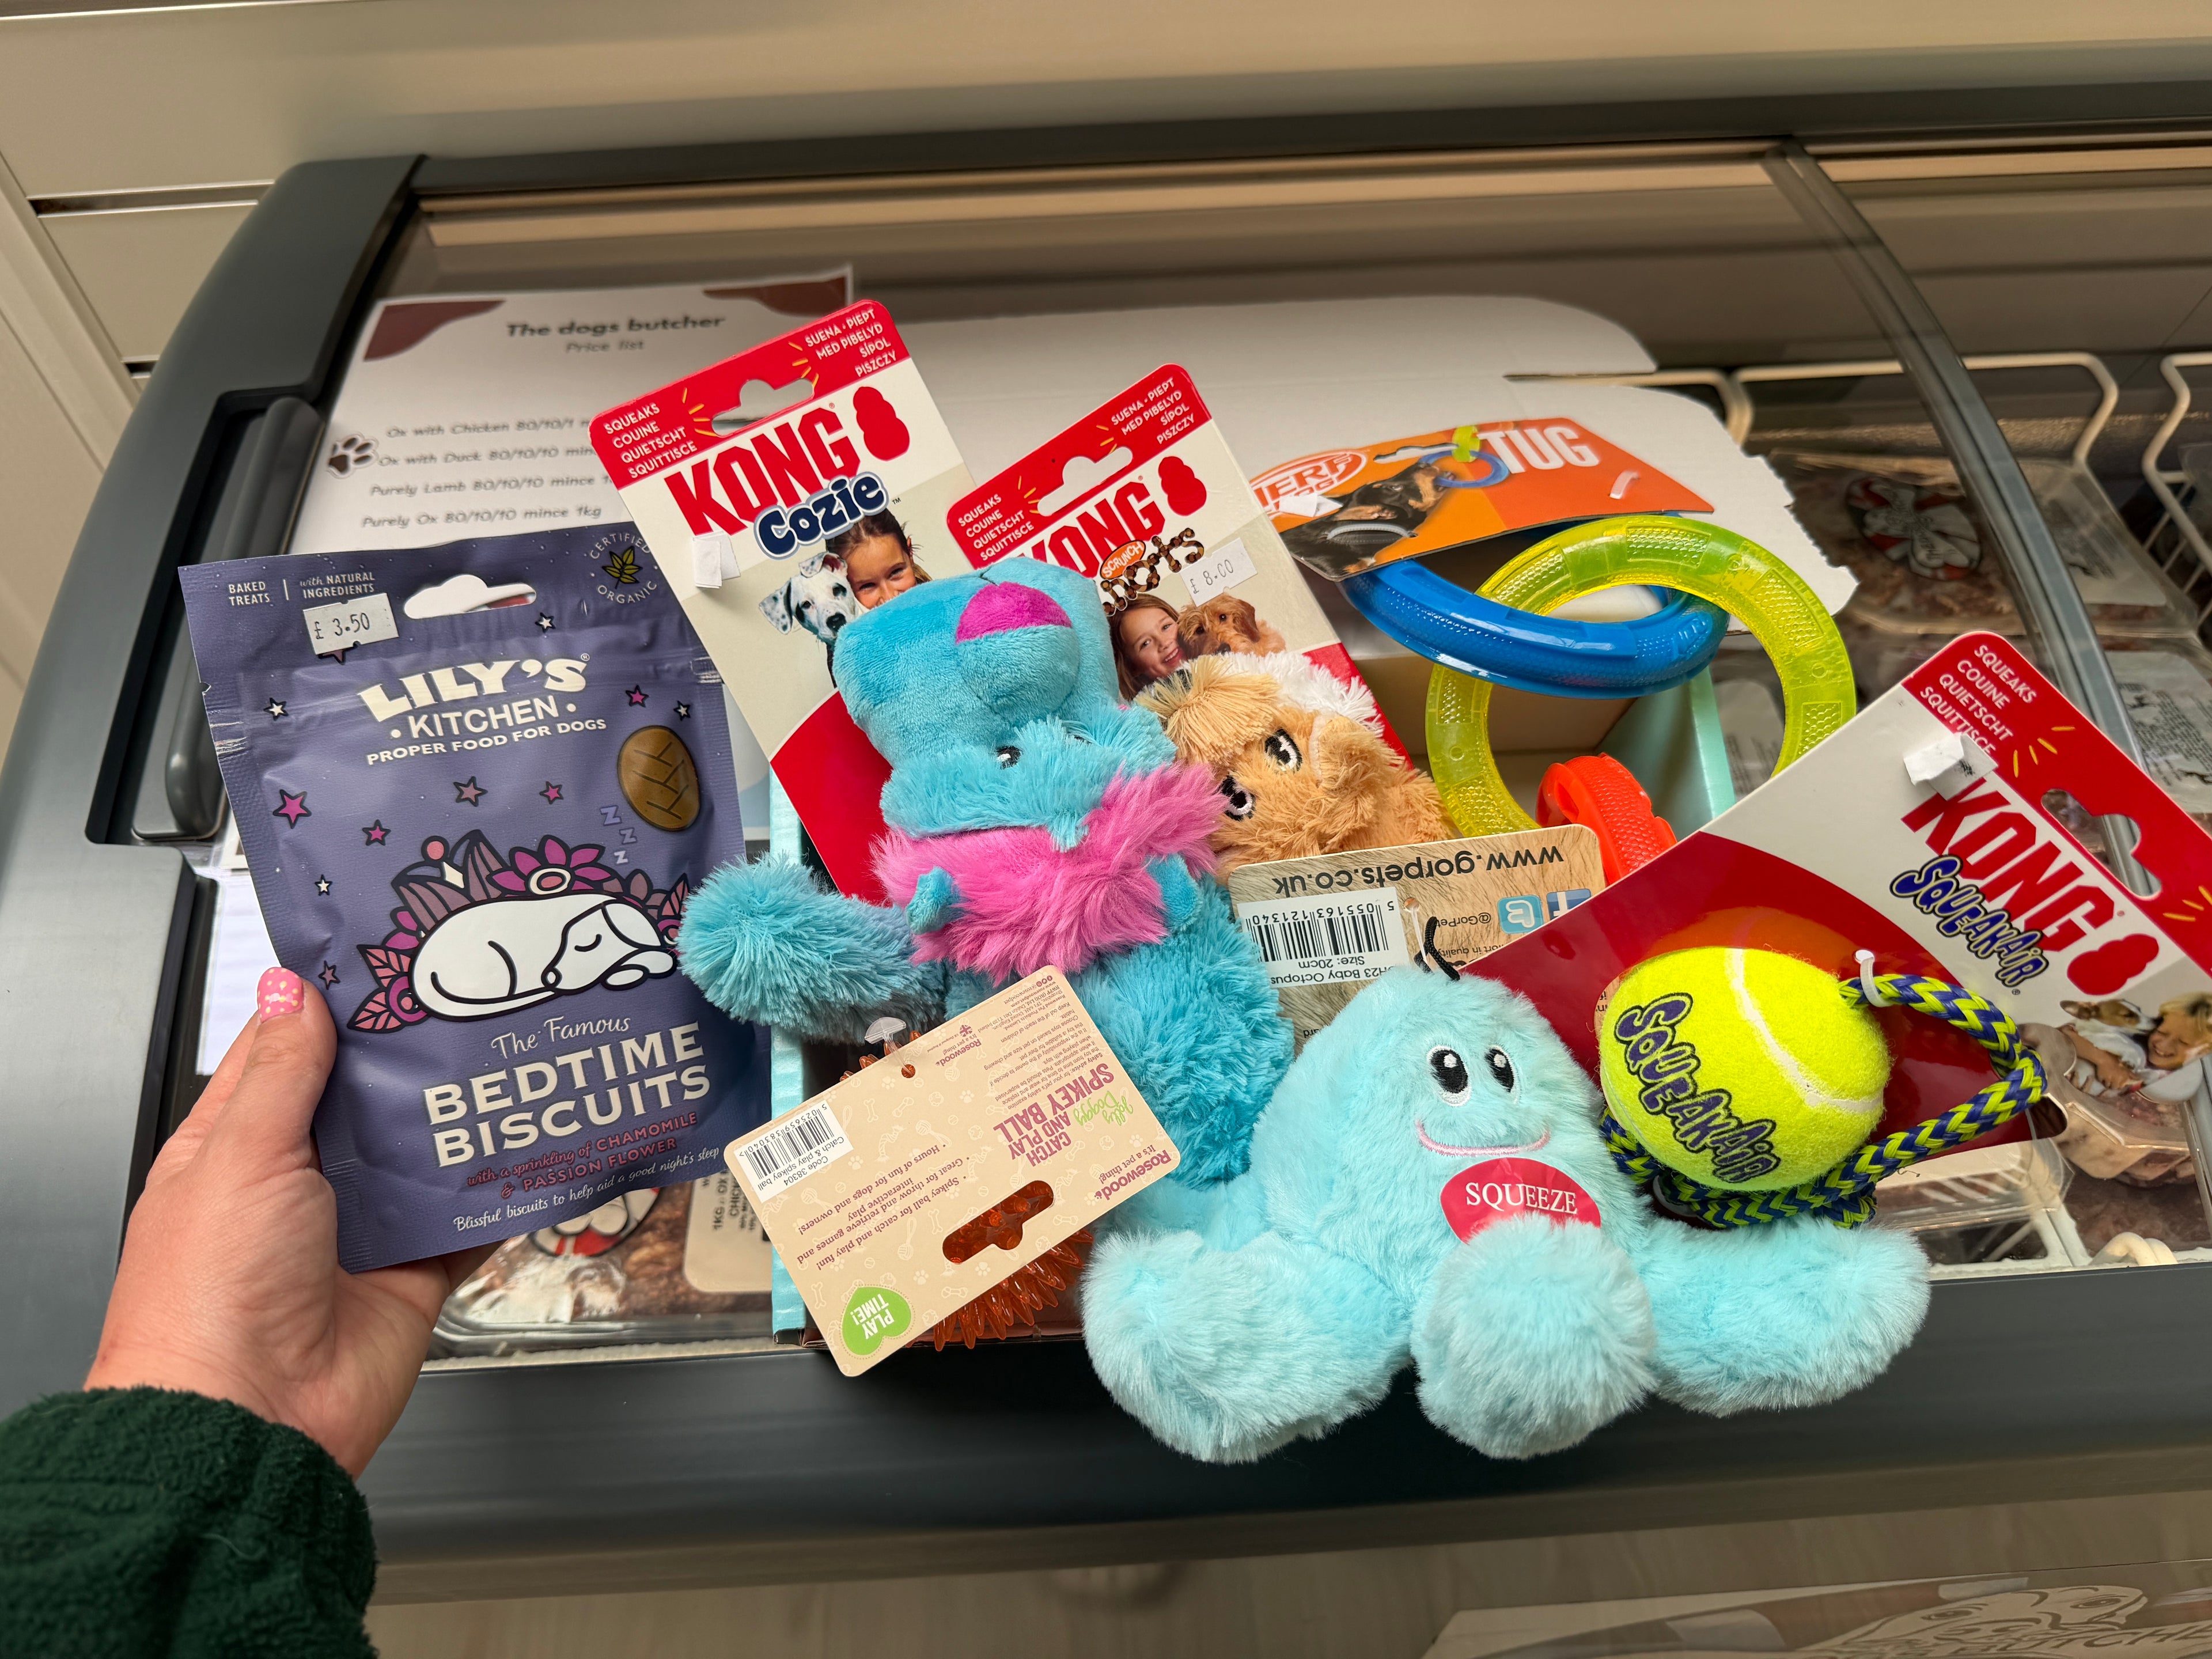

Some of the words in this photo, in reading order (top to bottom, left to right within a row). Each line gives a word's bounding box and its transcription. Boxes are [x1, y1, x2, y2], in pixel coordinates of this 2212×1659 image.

[506, 324, 549, 342] The
[559, 321, 618, 335] dogs
[628, 315, 724, 331] butcher
[806, 326, 842, 346] SUENA
[846, 309, 874, 328] PIEPT
[567, 342, 609, 358] Price
[619, 340, 644, 351] list
[816, 343, 840, 359] MED
[840, 324, 884, 349] PIBELYD
[860, 338, 891, 357] SÍPOL
[855, 351, 896, 377] PISZCZY
[1112, 402, 1143, 425] SUENA
[1148, 378, 1173, 401] PIEPT
[1122, 417, 1142, 435] MED
[1143, 392, 1181, 421] PIBELYD
[1161, 404, 1189, 425] SÍPOL
[605, 404, 660, 434] SQUEAKS
[1157, 414, 1194, 444] PISZCZY
[613, 422, 660, 448] COUINE
[622, 427, 685, 463] QUIETSCHT
[629, 441, 697, 478] SQUITTISCE
[1477, 426, 1600, 474] TUG
[664, 407, 861, 535] KONG
[756, 473, 887, 558] Cozie
[959, 495, 1001, 526] SQUEAKS
[967, 510, 1002, 537] COUINE
[974, 510, 1024, 548] QUIETSCHT
[980, 522, 1034, 560] SQUITTISCE
[590, 533, 650, 559] CERTIFIED
[1103, 542, 1144, 577] SCRUNCH
[229, 581, 266, 593] BAKED
[300, 577, 323, 586] with
[326, 572, 375, 584] NATURAL
[303, 584, 374, 599] INGREDIENTS
[1190, 578, 1199, 594] £
[229, 593, 270, 606] TREATS
[598, 581, 657, 604] ORGANIC
[315, 622, 324, 639] £
[332, 613, 370, 636] 3.50
[1957, 659, 2010, 710] COUINE
[1974, 645, 2037, 703] SQUEAKS
[358, 658, 587, 722] LILY'S
[409, 696, 560, 739] KITCHEN
[1939, 673, 2013, 741] QUIETSCHT
[367, 743, 446, 765] PROPER
[452, 735, 507, 751] FOOD
[512, 726, 551, 741] FOR
[557, 718, 608, 733] DOGS
[1272, 846, 1564, 897] www.gorpets.co.uk
[1901, 778, 2114, 952] KONG
[1252, 910, 1308, 925] 121340
[1316, 903, 1374, 918] 055163
[1298, 959, 1333, 968] 20cm
[1337, 956, 1365, 965] Size:
[1270, 973, 1324, 984] Octopus
[1328, 969, 1360, 980] Baby
[491, 1033, 539, 1060] The
[544, 1016, 631, 1041] Famous
[423, 1022, 704, 1125] BEDTIME
[1046, 1063, 1114, 1115] SPIKEY
[432, 1065, 710, 1167] BISCUITS
[785, 1109, 817, 1131] 025659
[1073, 1090, 1119, 1126] Doggy
[1102, 1096, 1133, 1126] Jolly
[993, 1102, 1047, 1142] BALL
[1041, 1111, 1071, 1137] AND
[467, 1169, 498, 1187] with
[500, 1168, 511, 1177] a
[513, 1152, 575, 1177] sprinkling
[578, 1141, 592, 1156] of
[596, 1112, 698, 1152] CHAMOMILE
[748, 1130, 781, 1153] 383040
[822, 1137, 844, 1152] Catch
[914, 1145, 940, 1163] Hours
[1008, 1129, 1043, 1160] PLAY
[1026, 1131, 1071, 1167] CATCH
[1143, 1145, 1156, 1155] It's
[501, 1183, 515, 1199] &
[523, 1160, 600, 1191] PASSION
[608, 1137, 677, 1168] FLOWER
[798, 1152, 813, 1166] play
[808, 1156, 828, 1170] Code
[903, 1161, 912, 1172] of
[938, 1158, 963, 1175] Great
[1122, 1156, 1136, 1168] pet
[757, 1178, 772, 1191] ball
[773, 1164, 797, 1181] spikey
[783, 1168, 807, 1186] 38304
[875, 1176, 888, 1187] for
[888, 1167, 903, 1178] fun
[926, 1173, 938, 1184] for
[1099, 1165, 1122, 1184] thing!
[1101, 1150, 1172, 1200] Rosewood
[453, 1208, 501, 1231] Blissful
[507, 1198, 548, 1218] biscuits
[553, 1195, 565, 1205] to
[570, 1184, 597, 1201] help
[597, 1176, 614, 1191] aid
[629, 1163, 656, 1181] good
[660, 1154, 694, 1172] night's
[698, 1147, 719, 1161] sleep
[853, 1185, 873, 1200] dogs
[868, 1177, 914, 1209] interactive
[900, 1181, 925, 1200] throw
[931, 1177, 959, 1198] Spikey
[1465, 1183, 1578, 1214] SQUEEZE
[834, 1198, 851, 1213] and
[849, 1205, 866, 1221] play
[880, 1198, 897, 1213] and
[900, 1206, 912, 1217] for
[913, 1195, 931, 1210] ball
[798, 1209, 833, 1235] owners!
[846, 1209, 880, 1232] retrieve
[874, 1215, 897, 1232] catch
[816, 1229, 844, 1251] games
[836, 1240, 855, 1257] play
[855, 1230, 873, 1245] and
[797, 1249, 815, 1264] and
[816, 1254, 835, 1270] fun!
[850, 1293, 889, 1325] TIME!
[862, 1309, 895, 1339] PLAY
